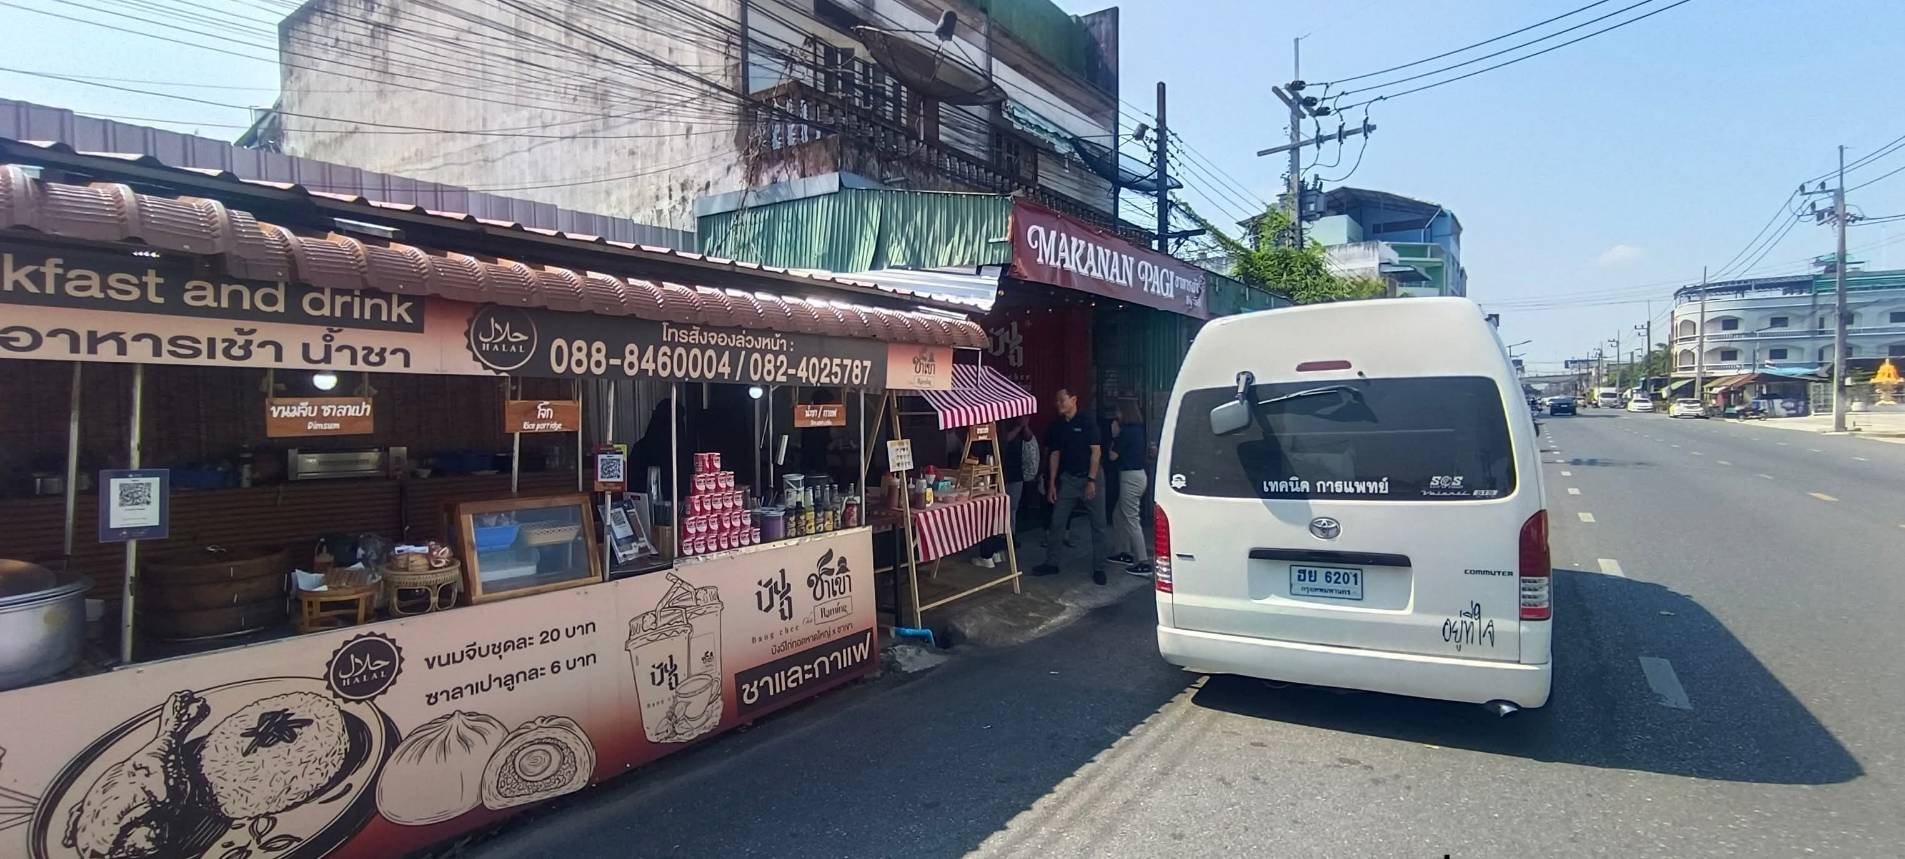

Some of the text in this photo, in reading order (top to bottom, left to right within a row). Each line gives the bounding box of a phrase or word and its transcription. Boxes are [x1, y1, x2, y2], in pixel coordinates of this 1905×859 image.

[1026, 224, 1175, 299] MAKANAN PAGI
[183, 279, 286, 314] and
[302, 286, 414, 324] drink
[478, 316, 529, 343] حلال
[661, 321, 787, 352] โทรสั่งจองล่วงหน้า
[0, 325, 412, 368] อาหารเช้า น้ำชา
[482, 342, 525, 353] HALAL
[550, 337, 732, 380] 088-8460004
[749, 352, 872, 386] 082-4025787
[270, 401, 318, 418] ขนมจีบ
[307, 421, 341, 430] Dimsum
[1263, 476, 1389, 494] เทคนิค การแพทย์
[1297, 569, 1358, 585] ฮย 6201
[1464, 569, 1514, 577] COMMUTER
[424, 620, 597, 670] ขนมจีบชุดละ 20 บาท
[338, 652, 391, 679] حلال
[341, 671, 388, 687] HALAL
[424, 651, 598, 706] ซาลาเปาลูกละ 6 บาท
[741, 632, 871, 705] ชาและกาแฟ
